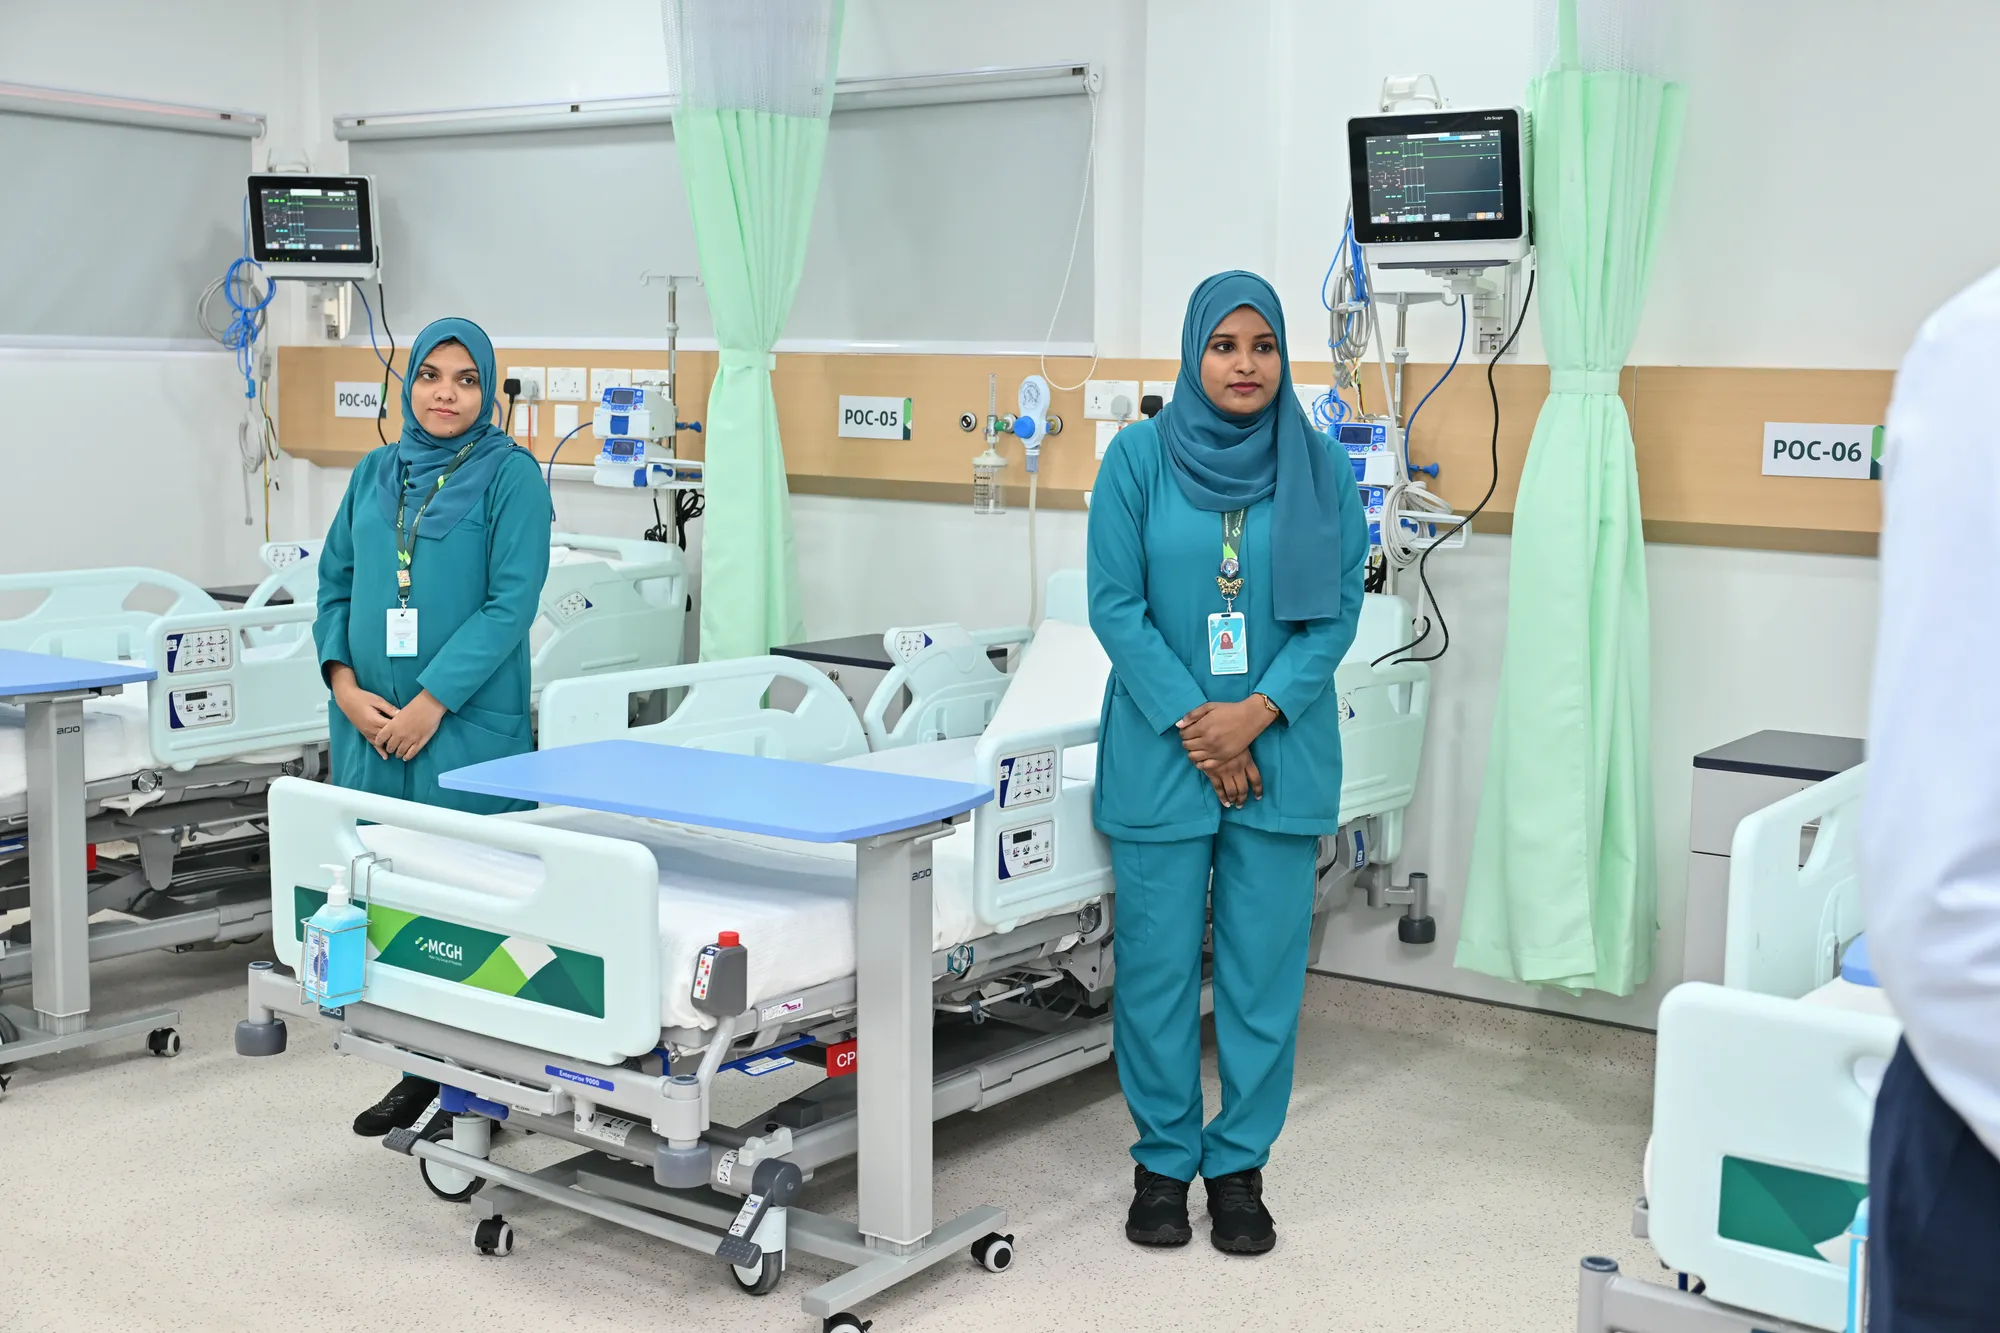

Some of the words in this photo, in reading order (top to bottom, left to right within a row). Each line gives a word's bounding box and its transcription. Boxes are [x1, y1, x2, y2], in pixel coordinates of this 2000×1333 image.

[339, 393, 377, 407] POC-04
[845, 409, 898, 426] POC-05
[1773, 439, 1862, 462] POC-06
[428, 938, 463, 961] MCGH
[836, 1051, 856, 1067] CP
[559, 1069, 585, 1083] Enterprise
[585, 1077, 600, 1086] 9000
